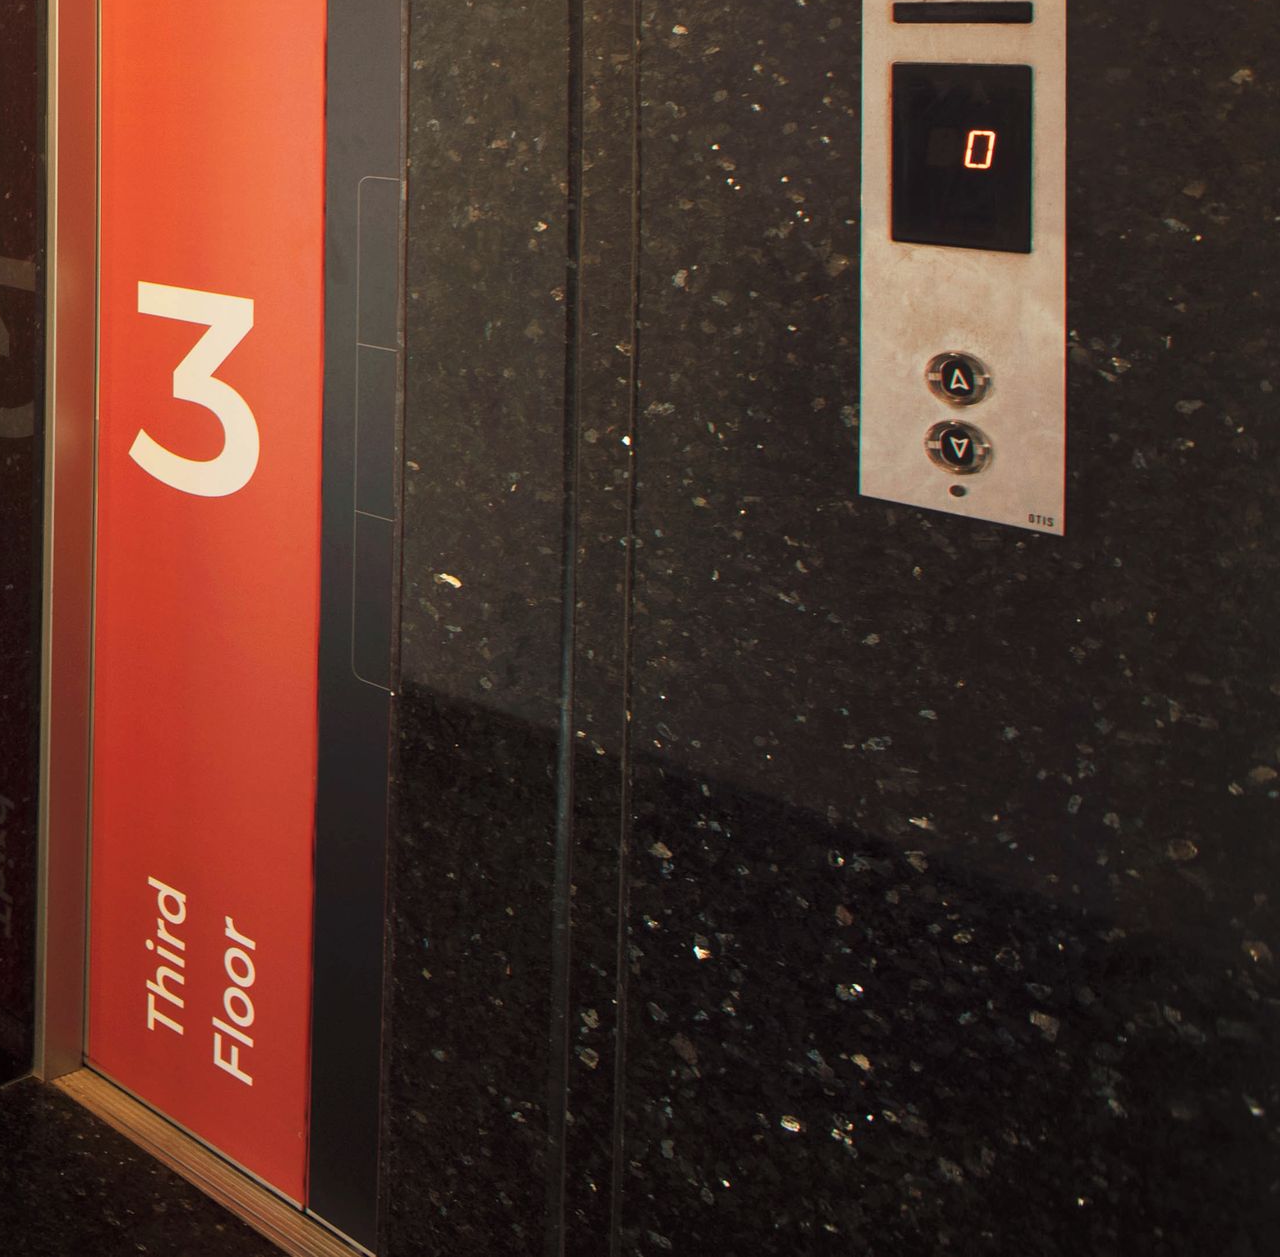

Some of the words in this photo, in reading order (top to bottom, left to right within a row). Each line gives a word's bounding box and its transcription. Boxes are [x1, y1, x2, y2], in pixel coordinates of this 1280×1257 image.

[963, 129, 996, 170] 0
[128, 280, 260, 498] 3
[145, 875, 187, 1036] Third
[212, 915, 257, 1087] Floor
